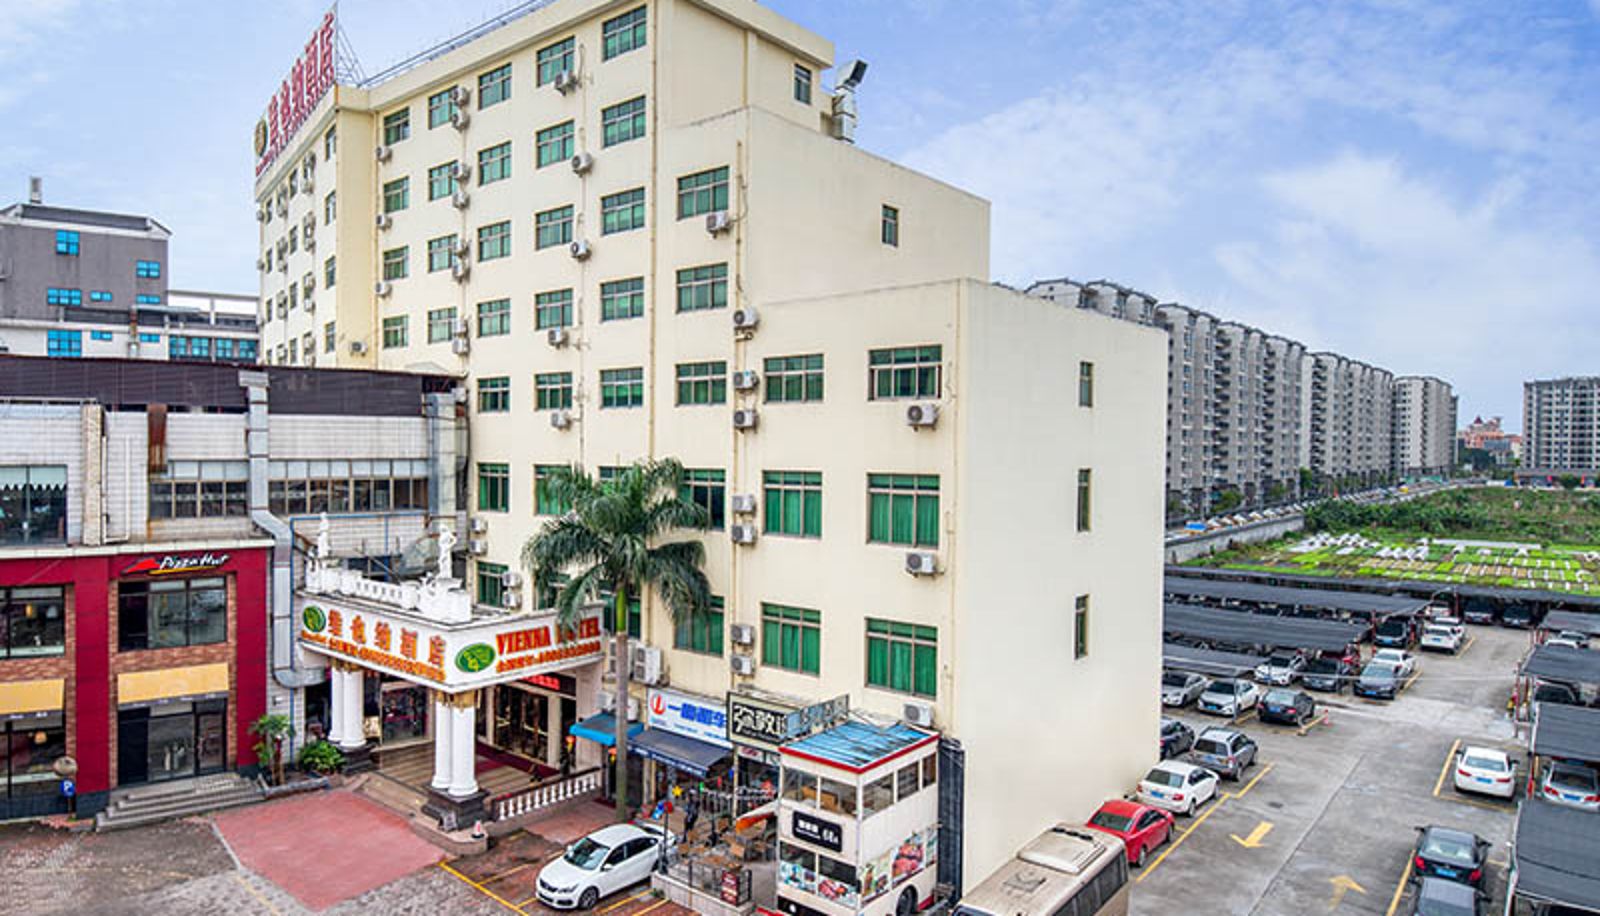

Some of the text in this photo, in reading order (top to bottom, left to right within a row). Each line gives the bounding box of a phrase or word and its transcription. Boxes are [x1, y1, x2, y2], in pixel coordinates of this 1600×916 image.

[160, 554, 230, 569] Pizza Hut
[328, 609, 447, 667] 维也纳酒店
[496, 625, 551, 656] VIENNA
